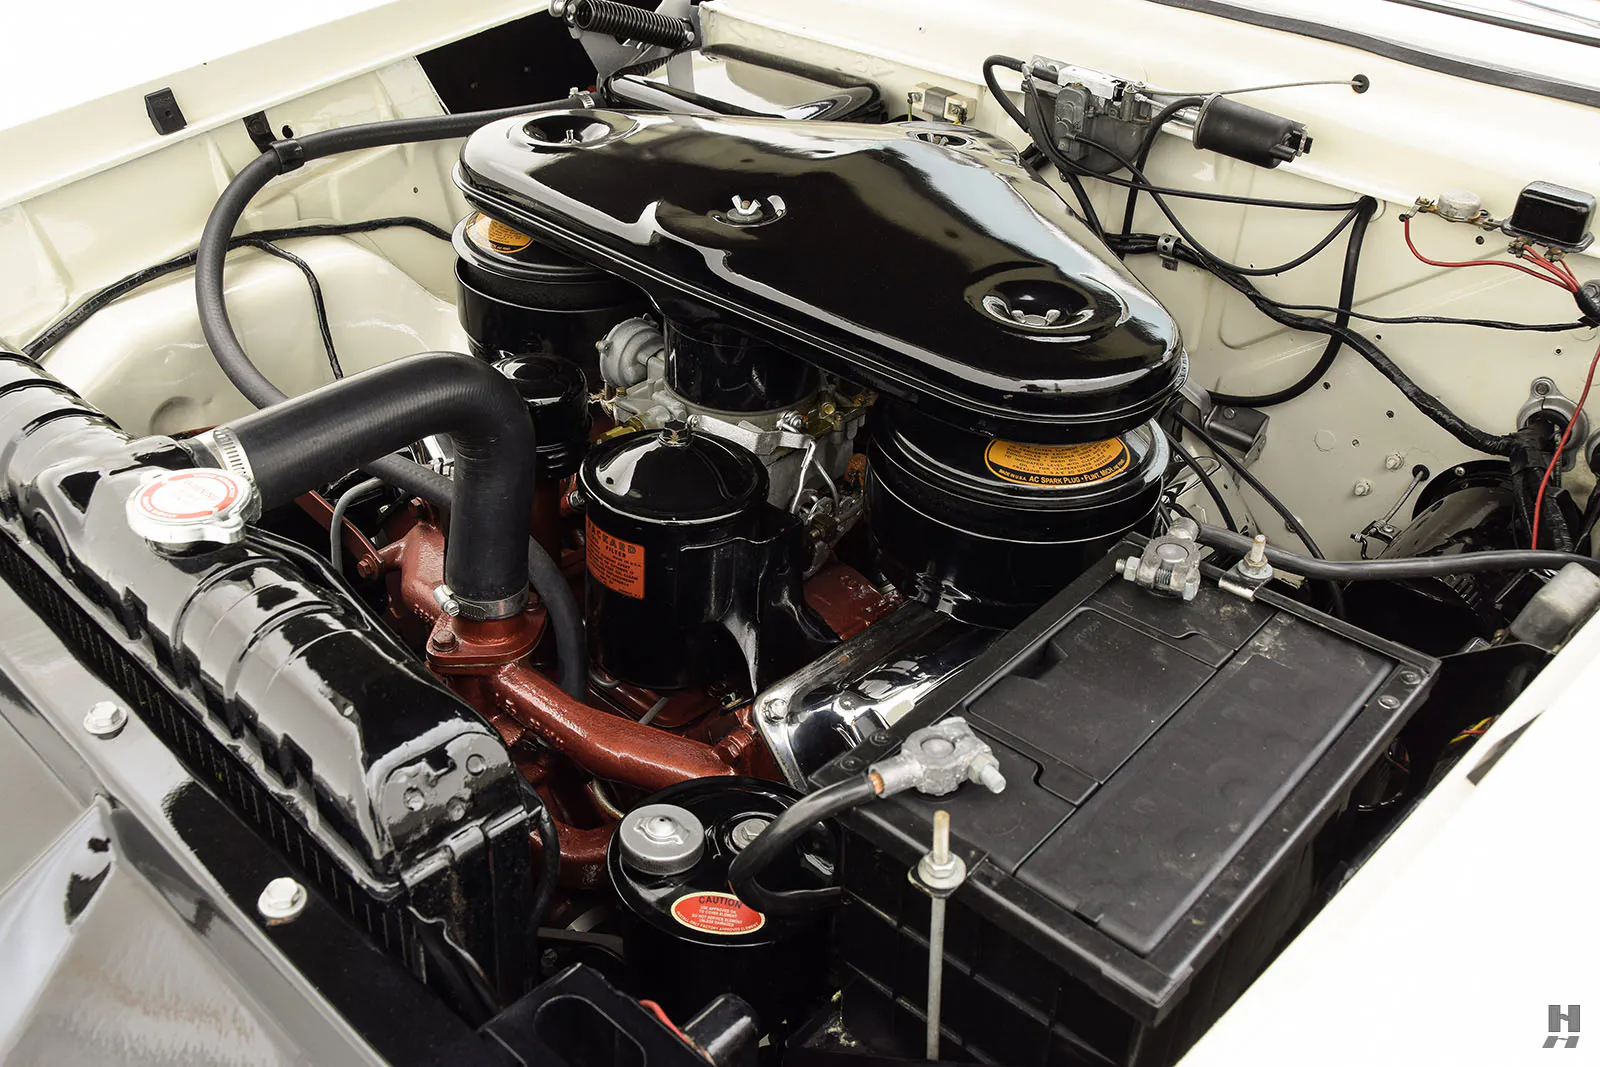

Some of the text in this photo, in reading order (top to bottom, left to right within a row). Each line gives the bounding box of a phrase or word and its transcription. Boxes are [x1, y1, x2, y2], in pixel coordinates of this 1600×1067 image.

[1028, 475, 1040, 483] AC
[1041, 476, 1063, 485] SPARK
[1063, 476, 1081, 484] PLUG
[588, 519, 637, 554] PACKARD
[606, 545, 626, 558] FILTER
[698, 896, 742, 909] CAUTION
